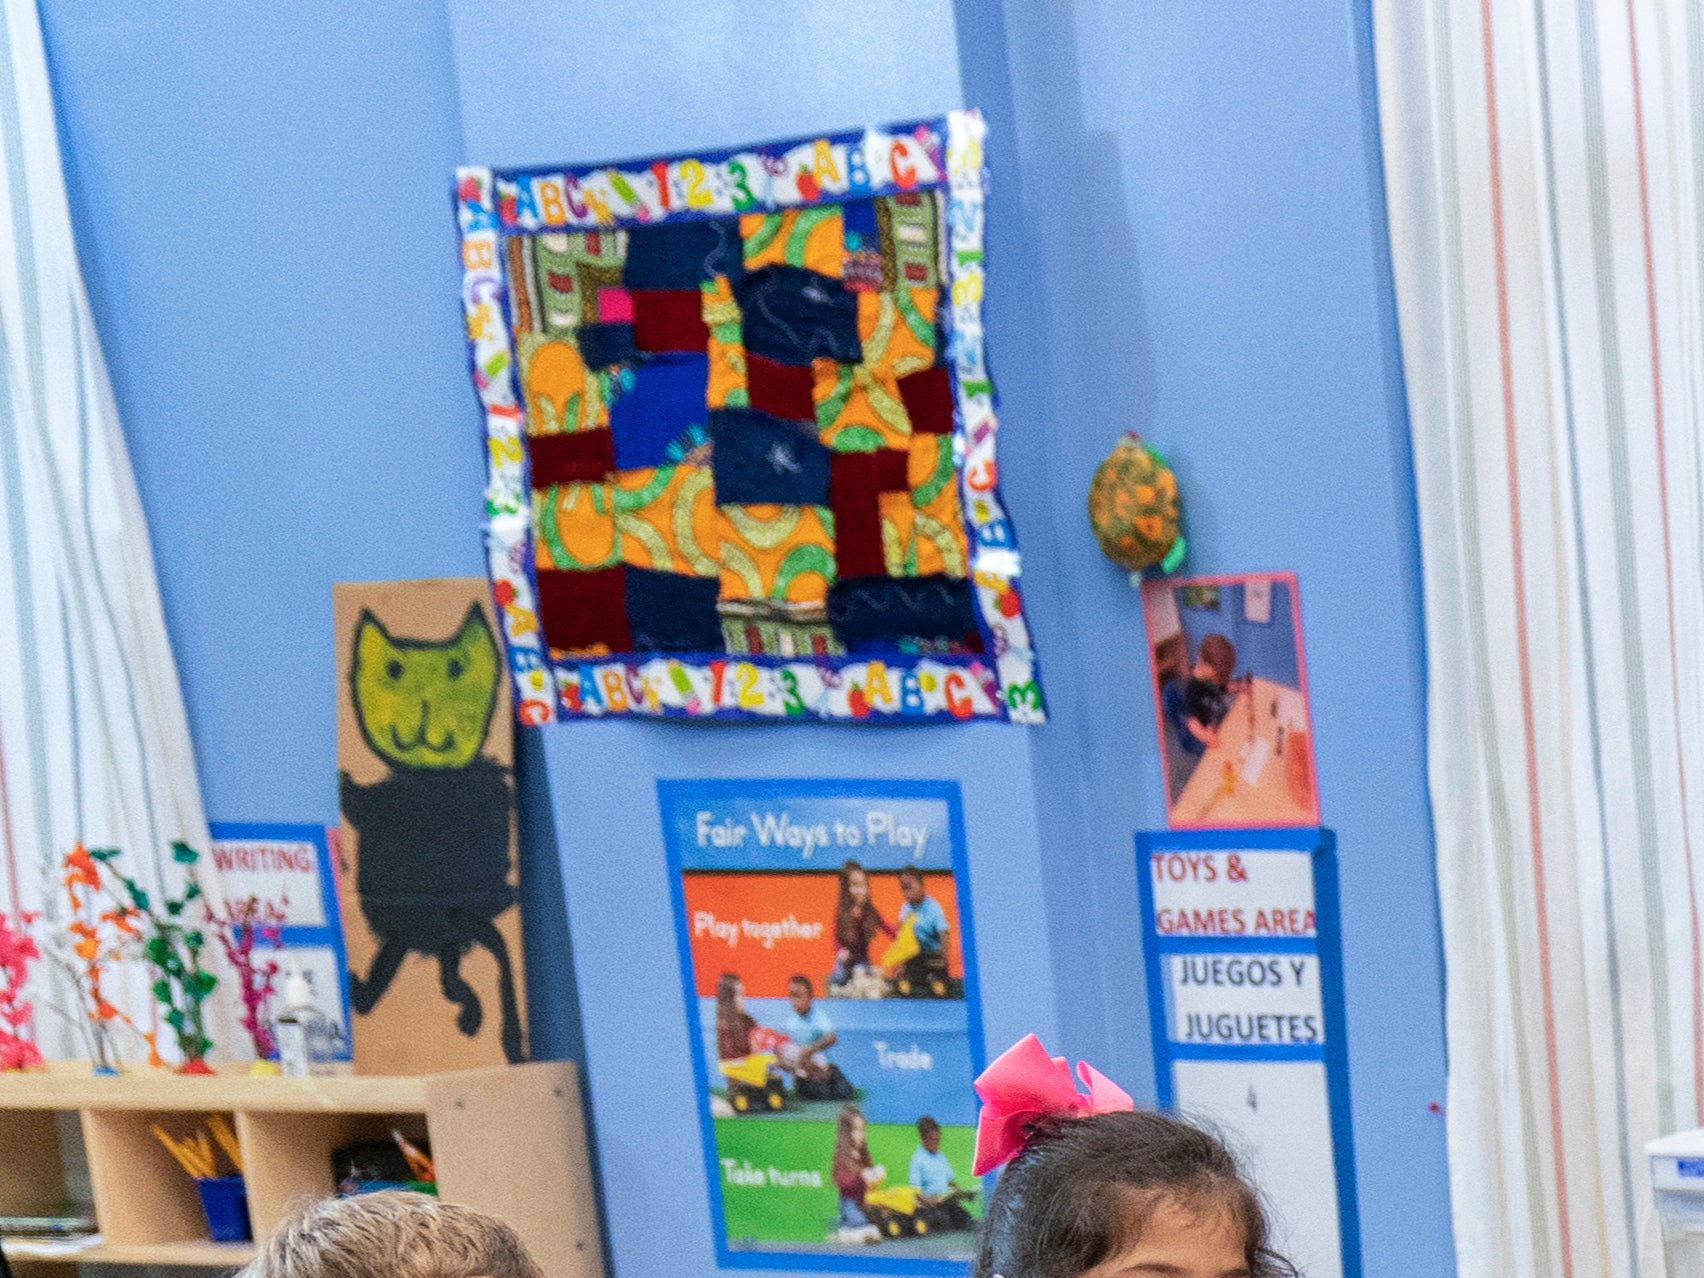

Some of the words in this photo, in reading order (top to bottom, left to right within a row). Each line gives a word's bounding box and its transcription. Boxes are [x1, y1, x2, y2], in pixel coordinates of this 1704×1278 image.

[697, 811, 748, 848] Fair
[752, 812, 829, 858] Ways
[834, 822, 861, 848] to
[866, 811, 928, 858] Play
[212, 847, 311, 872] WRITING
[1153, 855, 1216, 881] TOYS
[1227, 854, 1248, 881] &
[694, 911, 737, 946] Play
[743, 913, 822, 948] together
[1157, 908, 1245, 934] GAMES
[1254, 908, 1316, 933] AREA
[1182, 958, 1281, 986] JUEGOS
[1291, 959, 1304, 986] Y
[1186, 1013, 1317, 1041] JUGUETES
[873, 1041, 933, 1071] Trade
[722, 1158, 764, 1186] Take
[769, 1162, 821, 1188] turns
